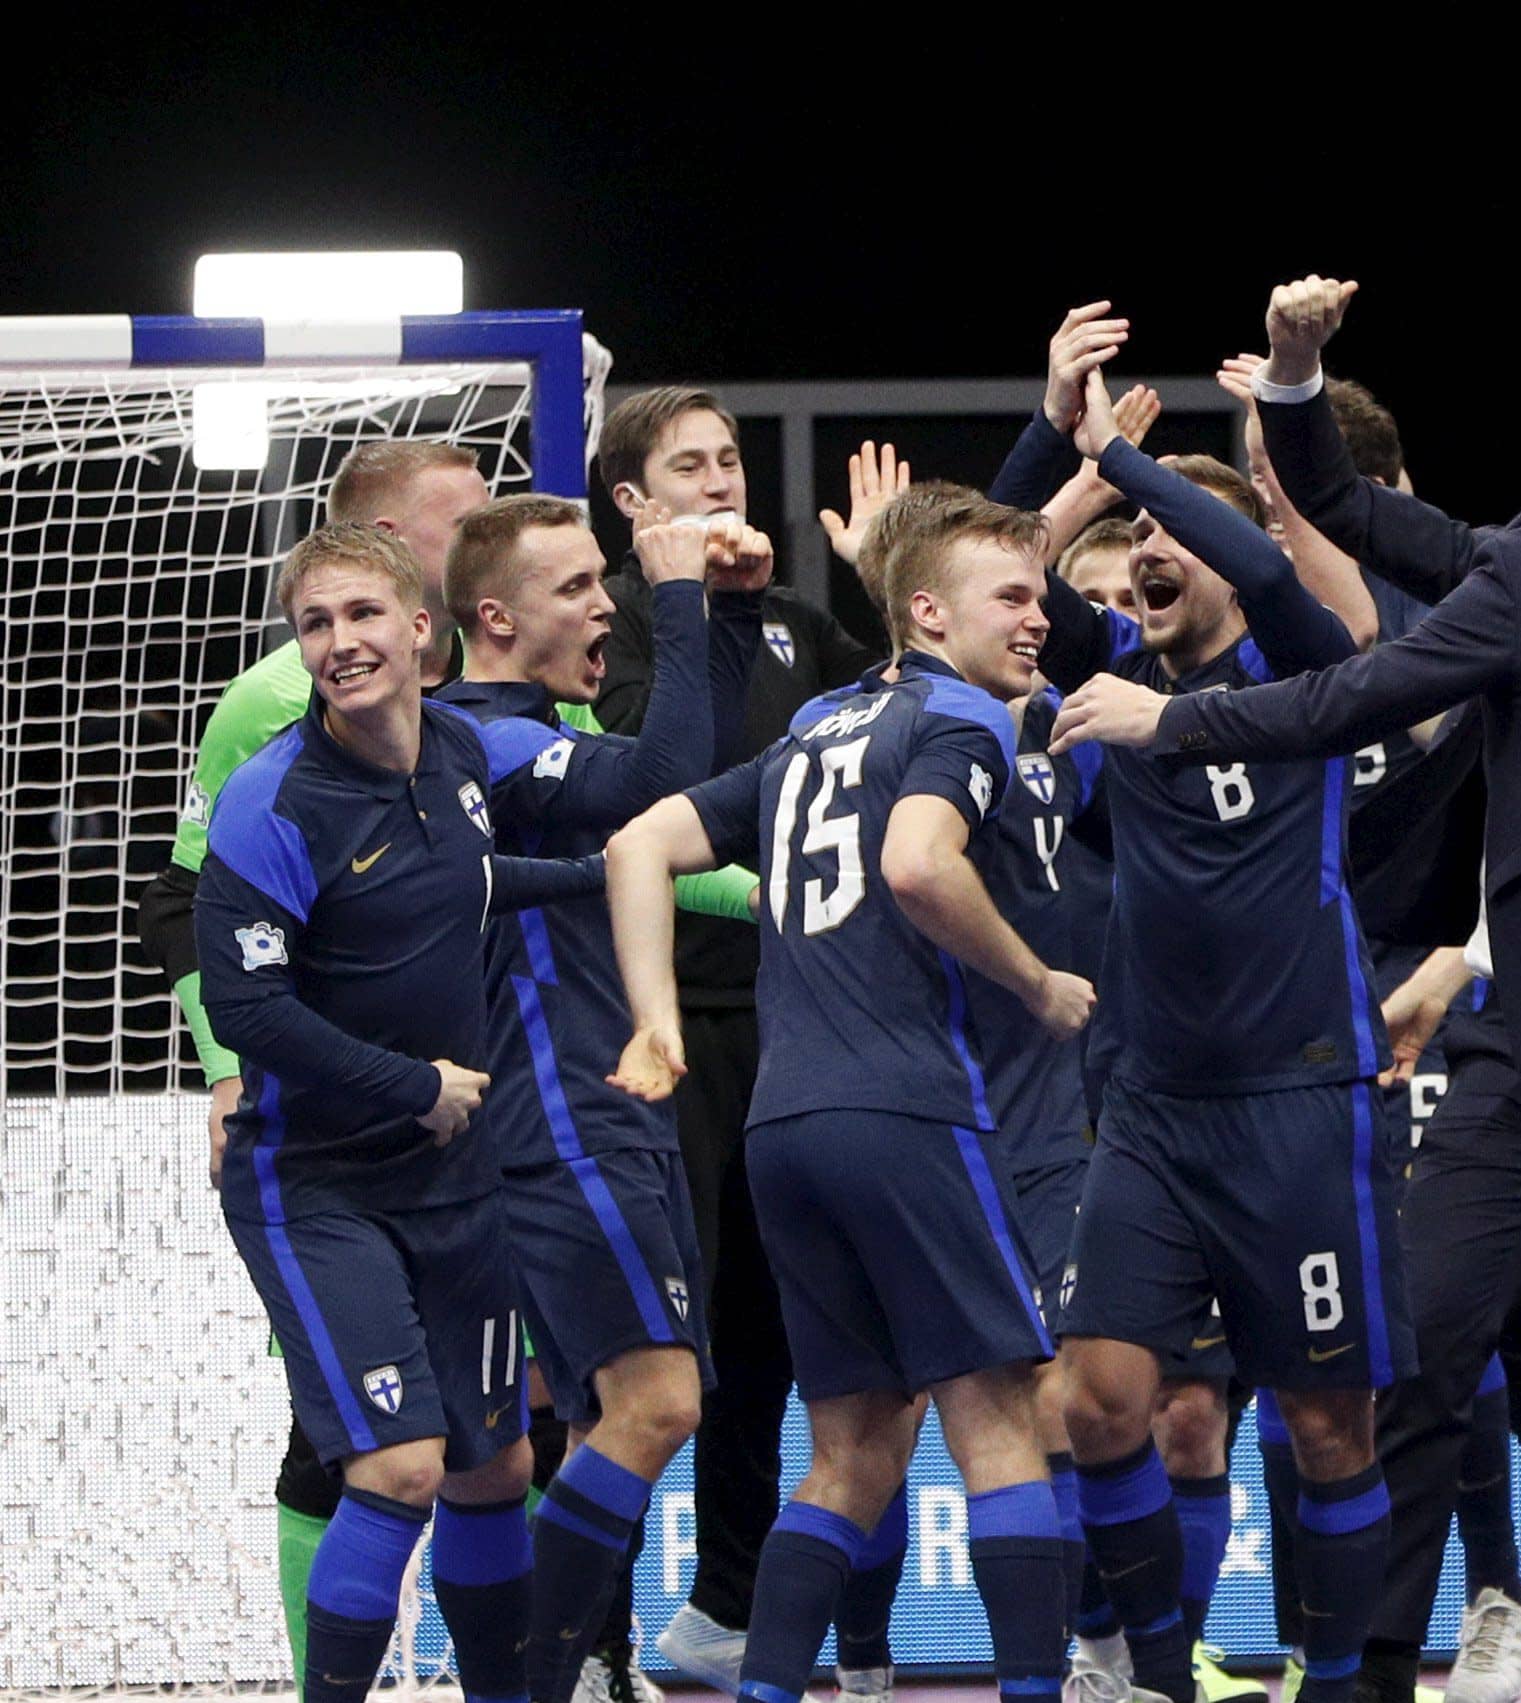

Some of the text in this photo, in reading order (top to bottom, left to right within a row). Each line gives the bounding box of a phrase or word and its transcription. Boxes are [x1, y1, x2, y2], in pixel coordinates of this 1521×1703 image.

[1206, 762, 1255, 822] 8
[769, 735, 870, 936] 15
[1033, 815, 1064, 891] 4
[1299, 1252, 1344, 1331] 8
[482, 1310, 517, 1395] 11
